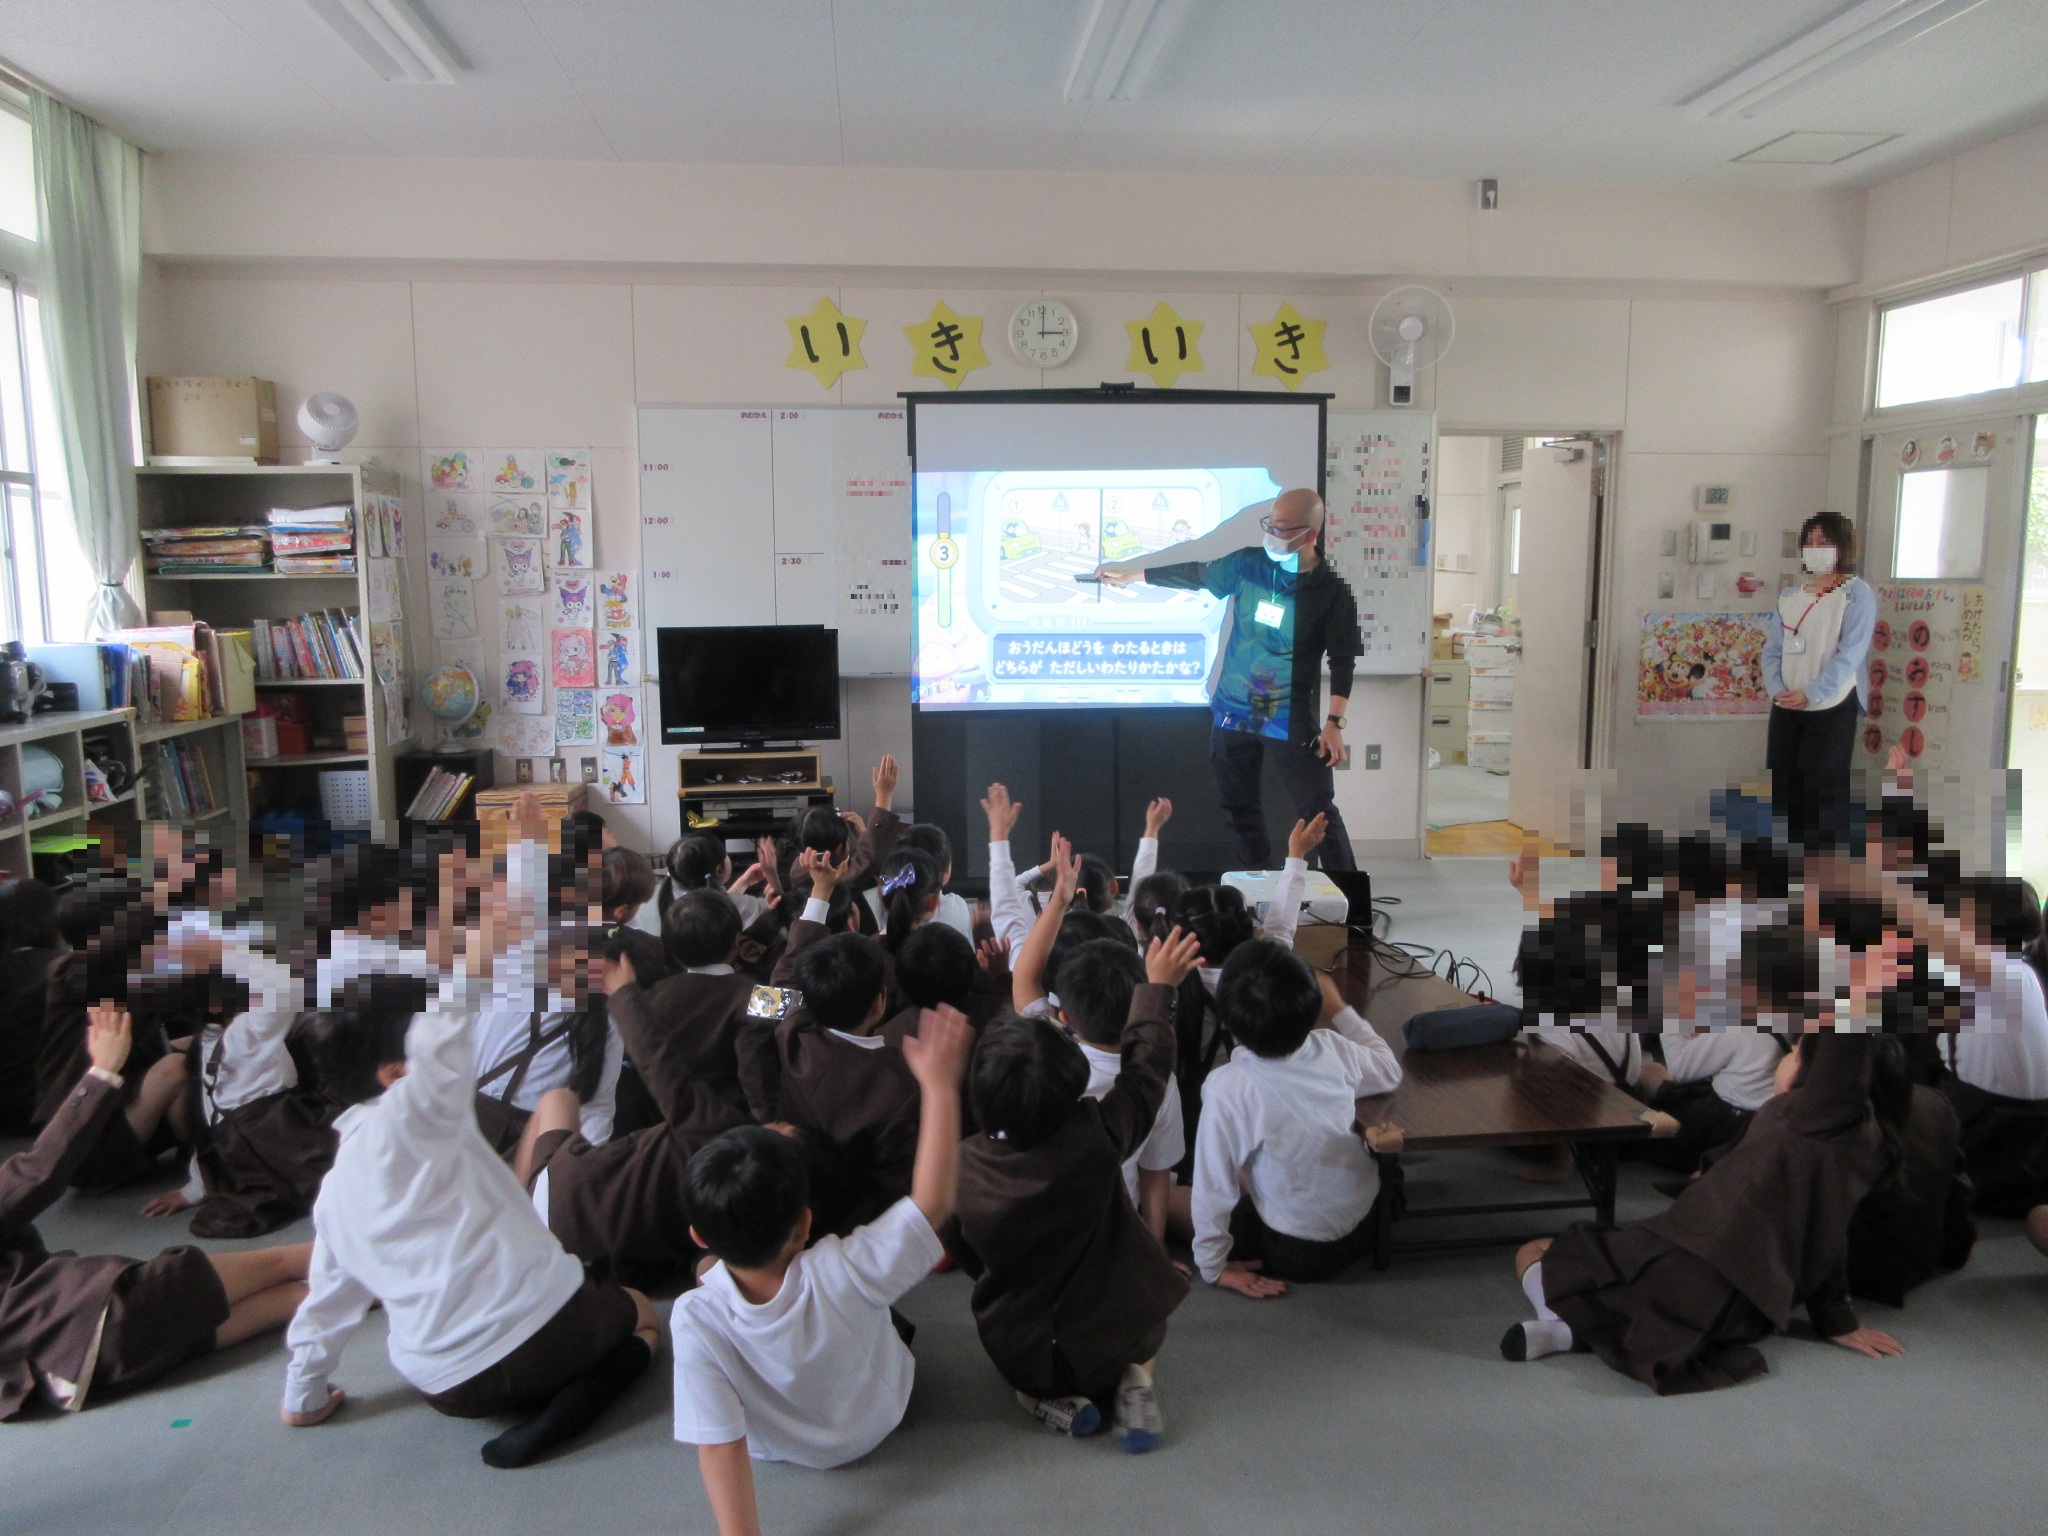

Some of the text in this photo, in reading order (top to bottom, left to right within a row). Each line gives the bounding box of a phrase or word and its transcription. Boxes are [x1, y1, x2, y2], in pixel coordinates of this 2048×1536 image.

[1028, 310, 1035, 318] 11
[1020, 318, 1030, 327] 10
[1058, 317, 1065, 325] 2
[1017, 329, 1024, 337] 9
[1062, 329, 1069, 337] 3
[1020, 340, 1028, 349] 8
[1059, 339, 1066, 347] 4
[801, 321, 1305, 374] い き い き
[1030, 349, 1036, 357] 7
[1040, 352, 1048, 360] 6
[1051, 348, 1058, 357] 5
[780, 411, 799, 420] 2:00
[643, 463, 669, 471] 11:00
[643, 517, 669, 525] 12:00
[939, 545, 949, 562] 3
[781, 557, 802, 565] 2:30
[653, 571, 671, 579] 1:00
[1961, 593, 1972, 642] しめる
[1913, 625, 1930, 647] の
[1008, 640, 1187, 656] おうだんほどうを わたるときは
[995, 660, 1201, 676] どちらが ただしいわたりかたかな?
[1909, 729, 1916, 756] し
